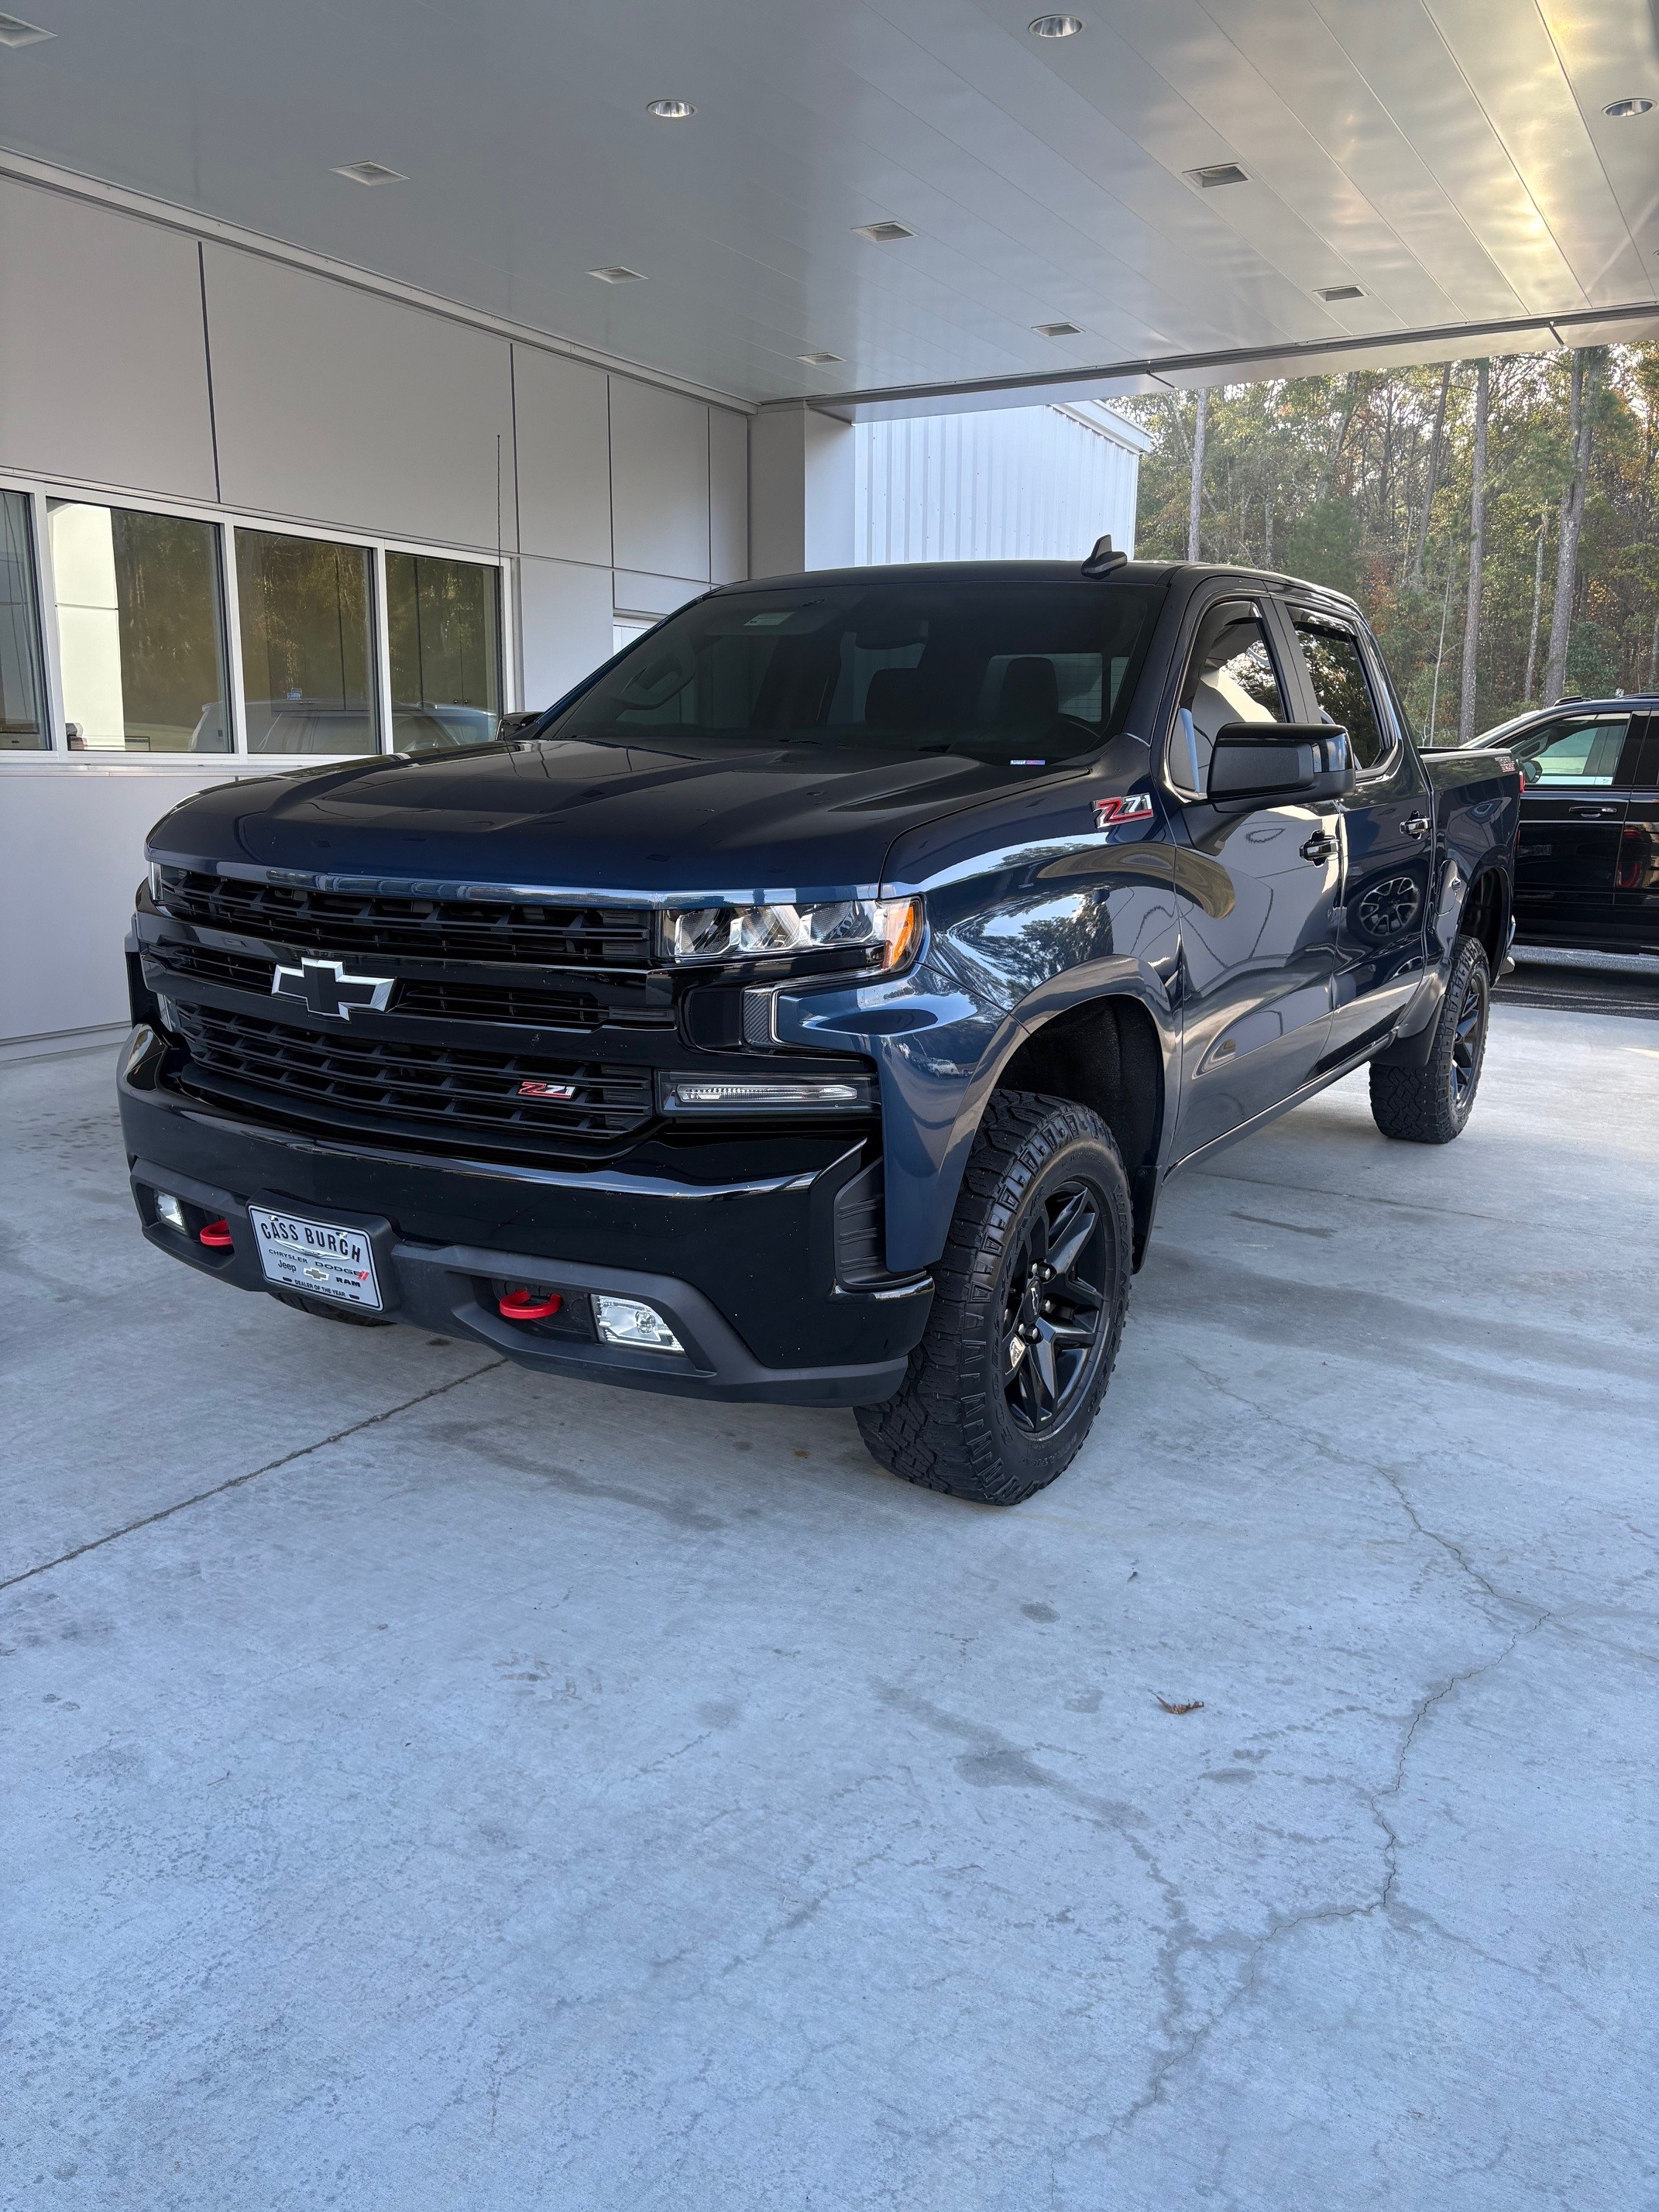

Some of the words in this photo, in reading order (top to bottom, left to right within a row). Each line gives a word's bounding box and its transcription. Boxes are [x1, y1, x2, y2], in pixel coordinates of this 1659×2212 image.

[1494, 756, 1515, 766] TRAIL
[1092, 792, 1154, 829] Z71
[518, 1081, 575, 1099] Z71
[260, 1222, 299, 1241] CASS
[304, 1227, 361, 1263] BURCH
[269, 1249, 308, 1264] CHRYSLER
[314, 1261, 362, 1276] DODGE
[278, 1259, 297, 1273] Jeep
[335, 1277, 362, 1288] RAM
[294, 1279, 314, 1290] DEALER
[331, 1288, 346, 1297] YEAR
